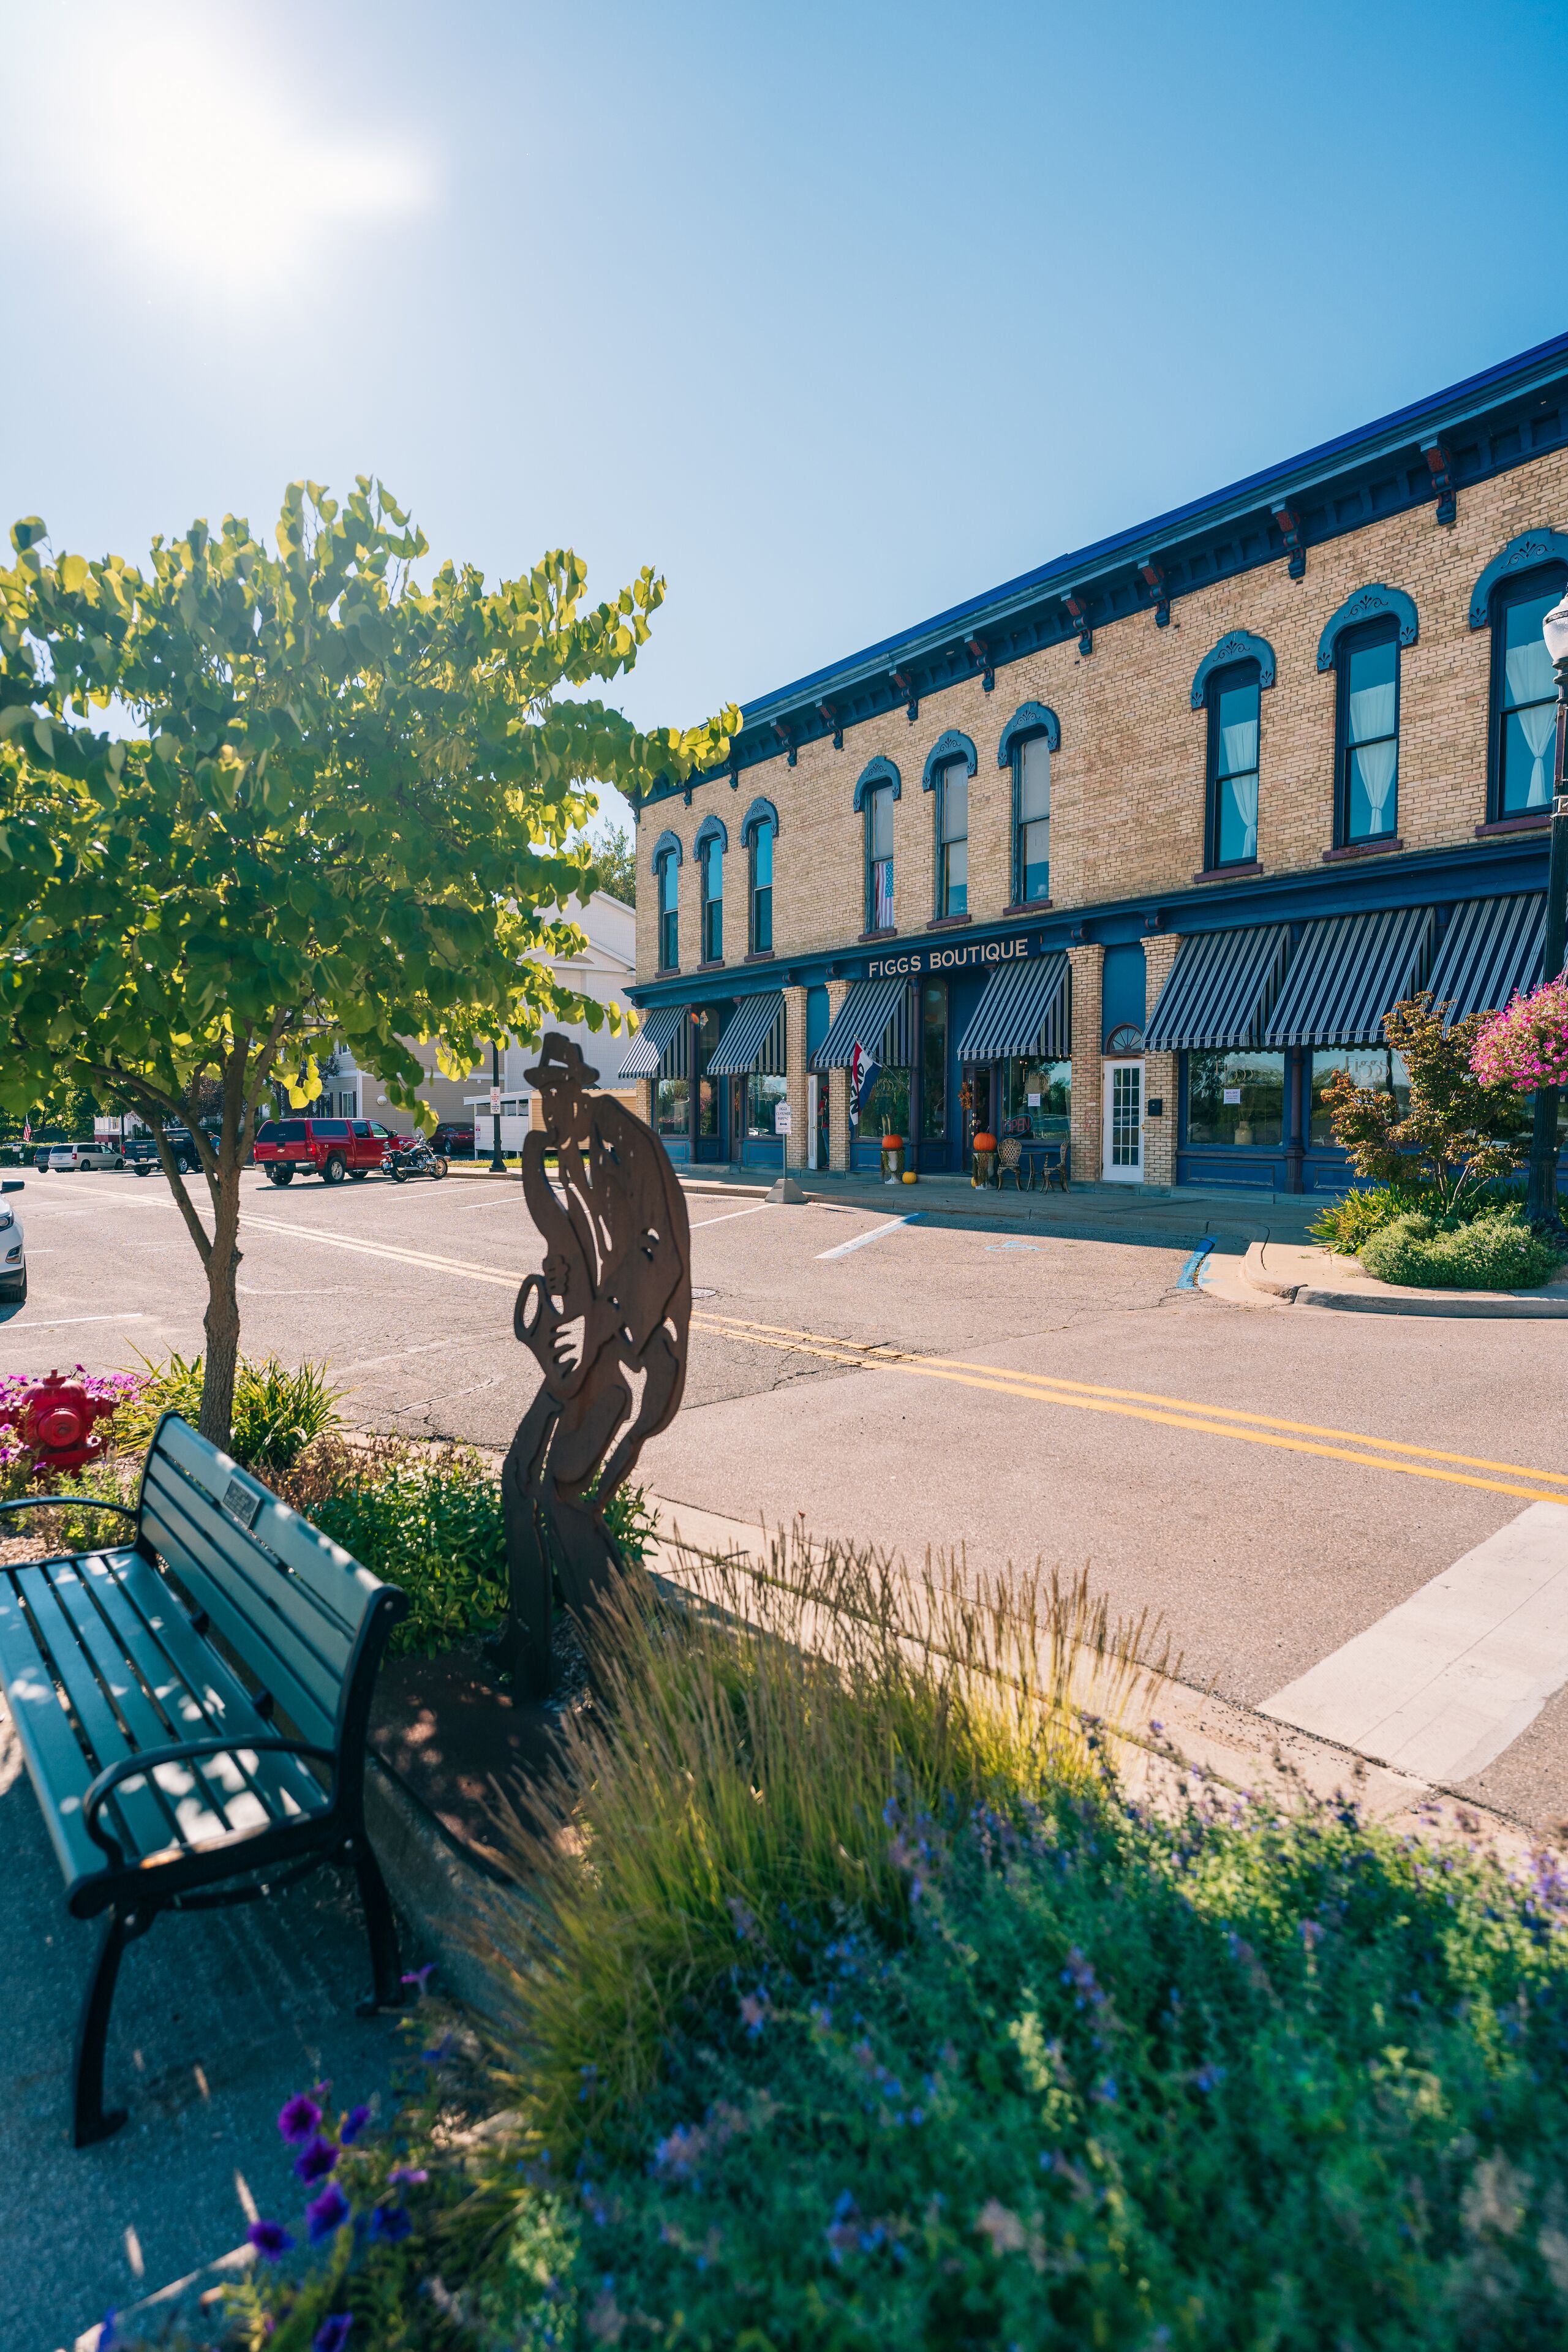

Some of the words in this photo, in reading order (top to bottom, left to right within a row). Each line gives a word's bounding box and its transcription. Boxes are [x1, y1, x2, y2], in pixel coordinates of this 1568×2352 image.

[869, 955, 921, 978] FIGGS
[930, 938, 1028, 970] BOUTIQUE
[1345, 1055, 1390, 1079] Figgs
[1004, 1117, 1030, 1134] OPEN
